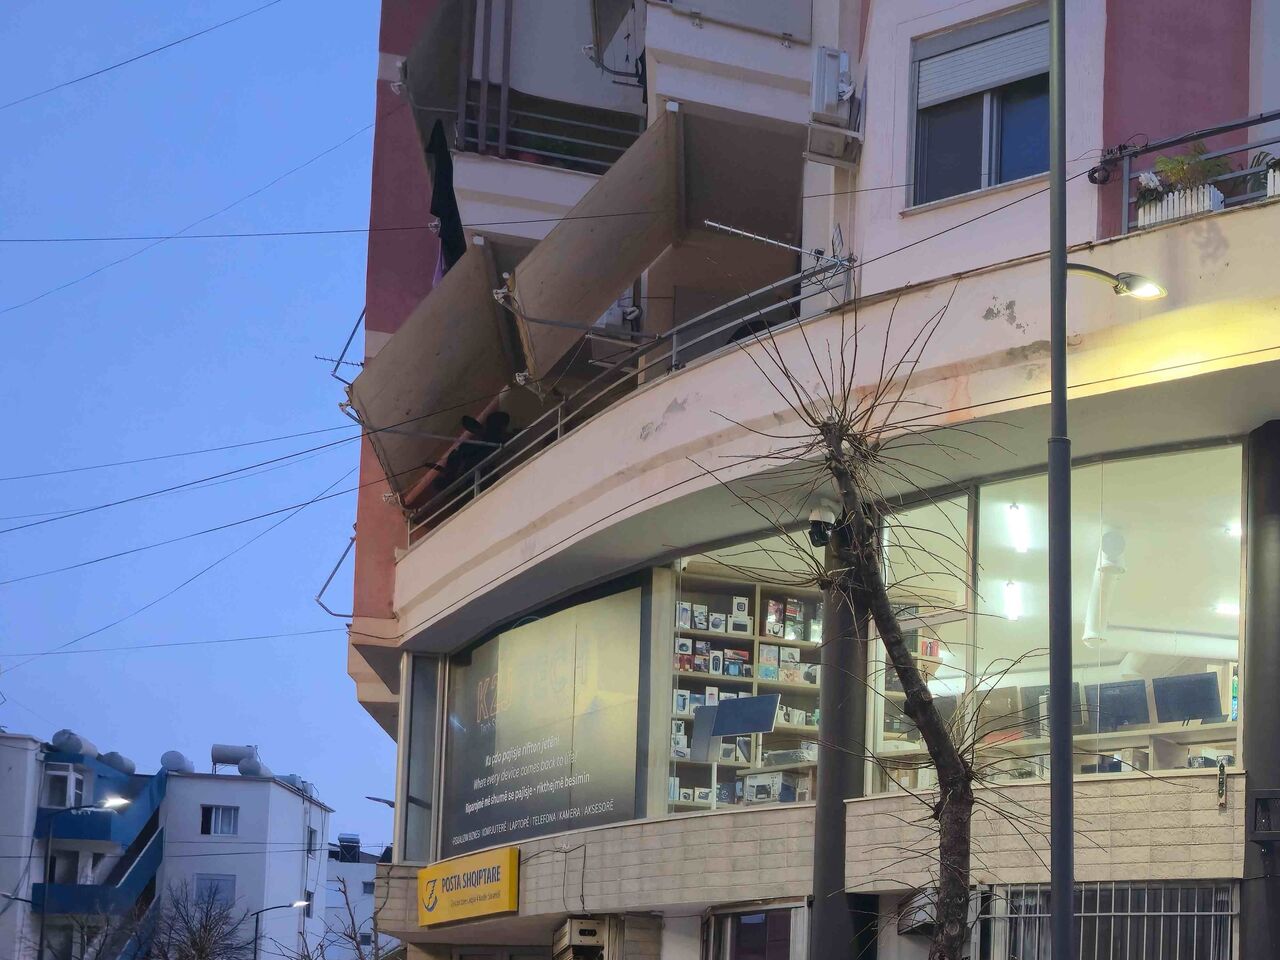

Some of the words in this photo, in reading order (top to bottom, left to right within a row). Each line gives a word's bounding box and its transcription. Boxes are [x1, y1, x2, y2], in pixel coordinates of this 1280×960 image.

[486, 773, 501, 788] every
[500, 767, 520, 782] device
[520, 762, 540, 778] comes
[540, 757, 556, 772] back
[556, 756, 564, 767] to
[564, 771, 590, 788] besimin
[509, 816, 531, 831] LAPTOPË
[532, 811, 556, 826] TELEFONA
[558, 807, 581, 821] KAMERA
[584, 799, 615, 815] AKSESORË
[441, 874, 462, 894] POSTA
[462, 865, 501, 889] SHQIPTARE
